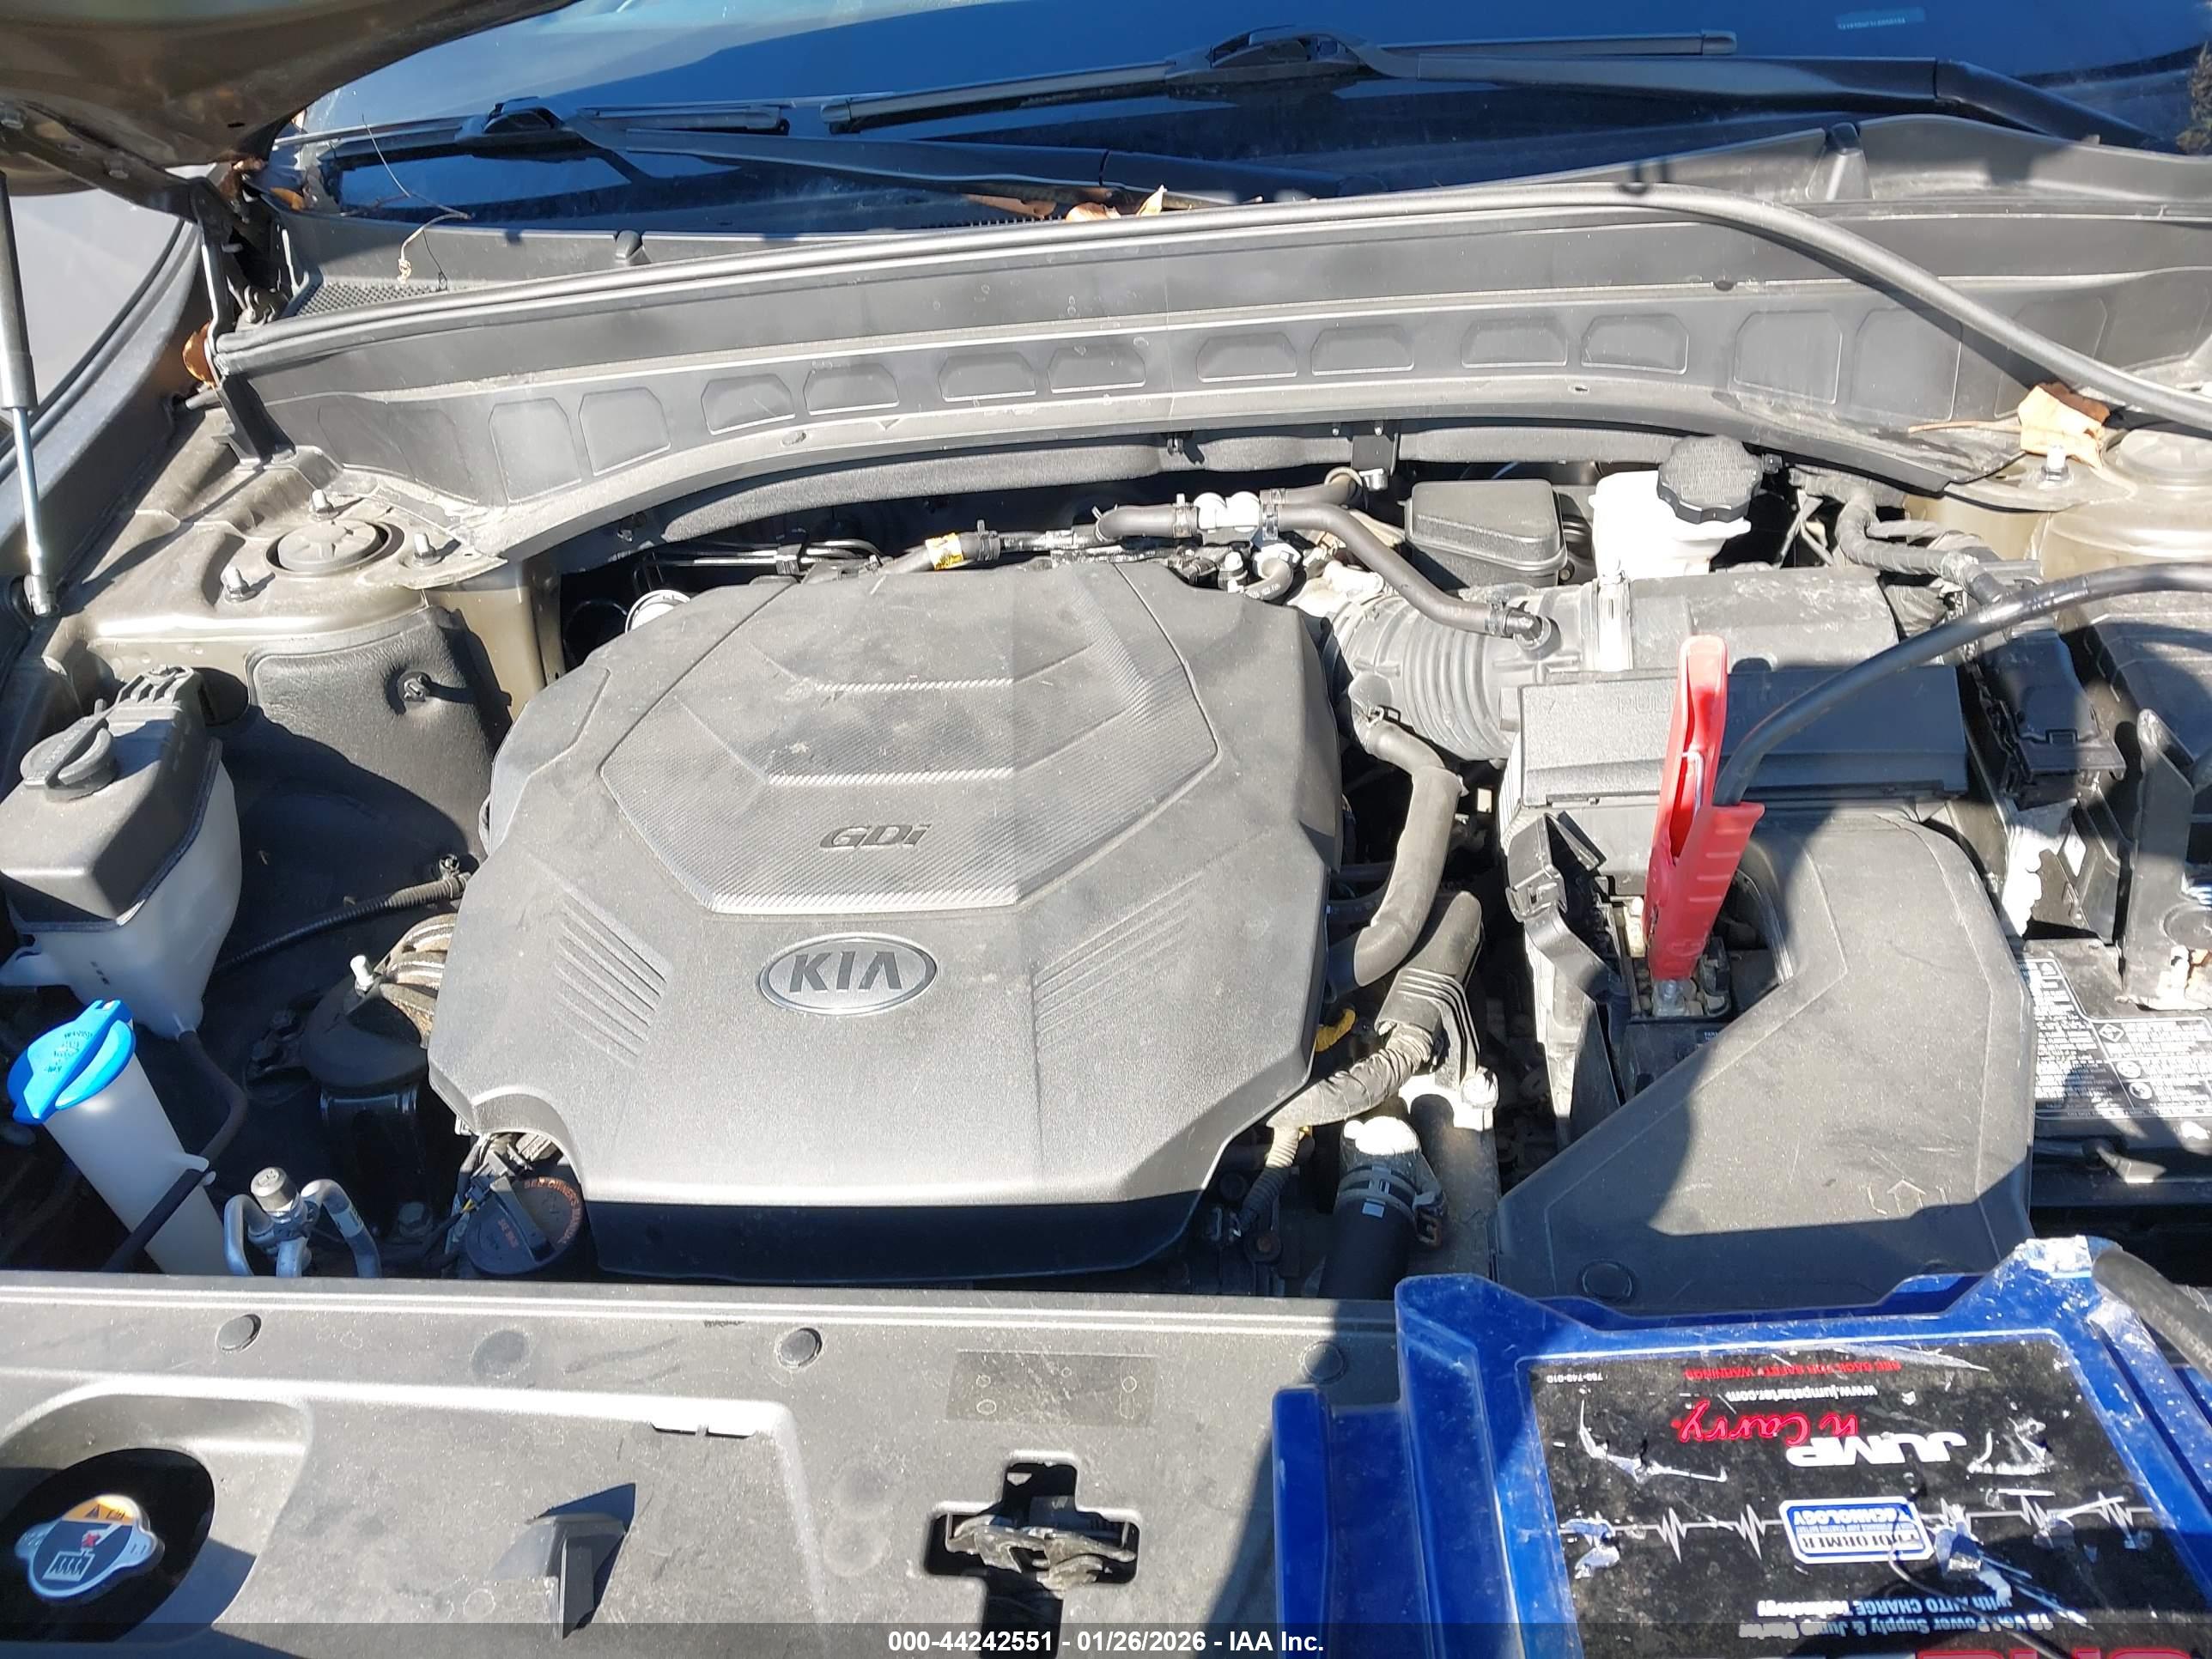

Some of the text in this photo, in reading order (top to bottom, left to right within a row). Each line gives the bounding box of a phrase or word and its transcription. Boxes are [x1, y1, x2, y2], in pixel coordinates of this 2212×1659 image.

[819, 823, 932, 849] GDi
[788, 951, 902, 994] KIA
[1725, 1384, 1878, 1403] www.jumpstarter.com
[1786, 1431, 1967, 1468] JUMP
[1852, 1599, 1923, 1616] CHARGE
[1851, 1621, 1868, 1637] &
[1871, 1616, 1930, 1636] Supply
[1932, 1617, 1990, 1632] Power
